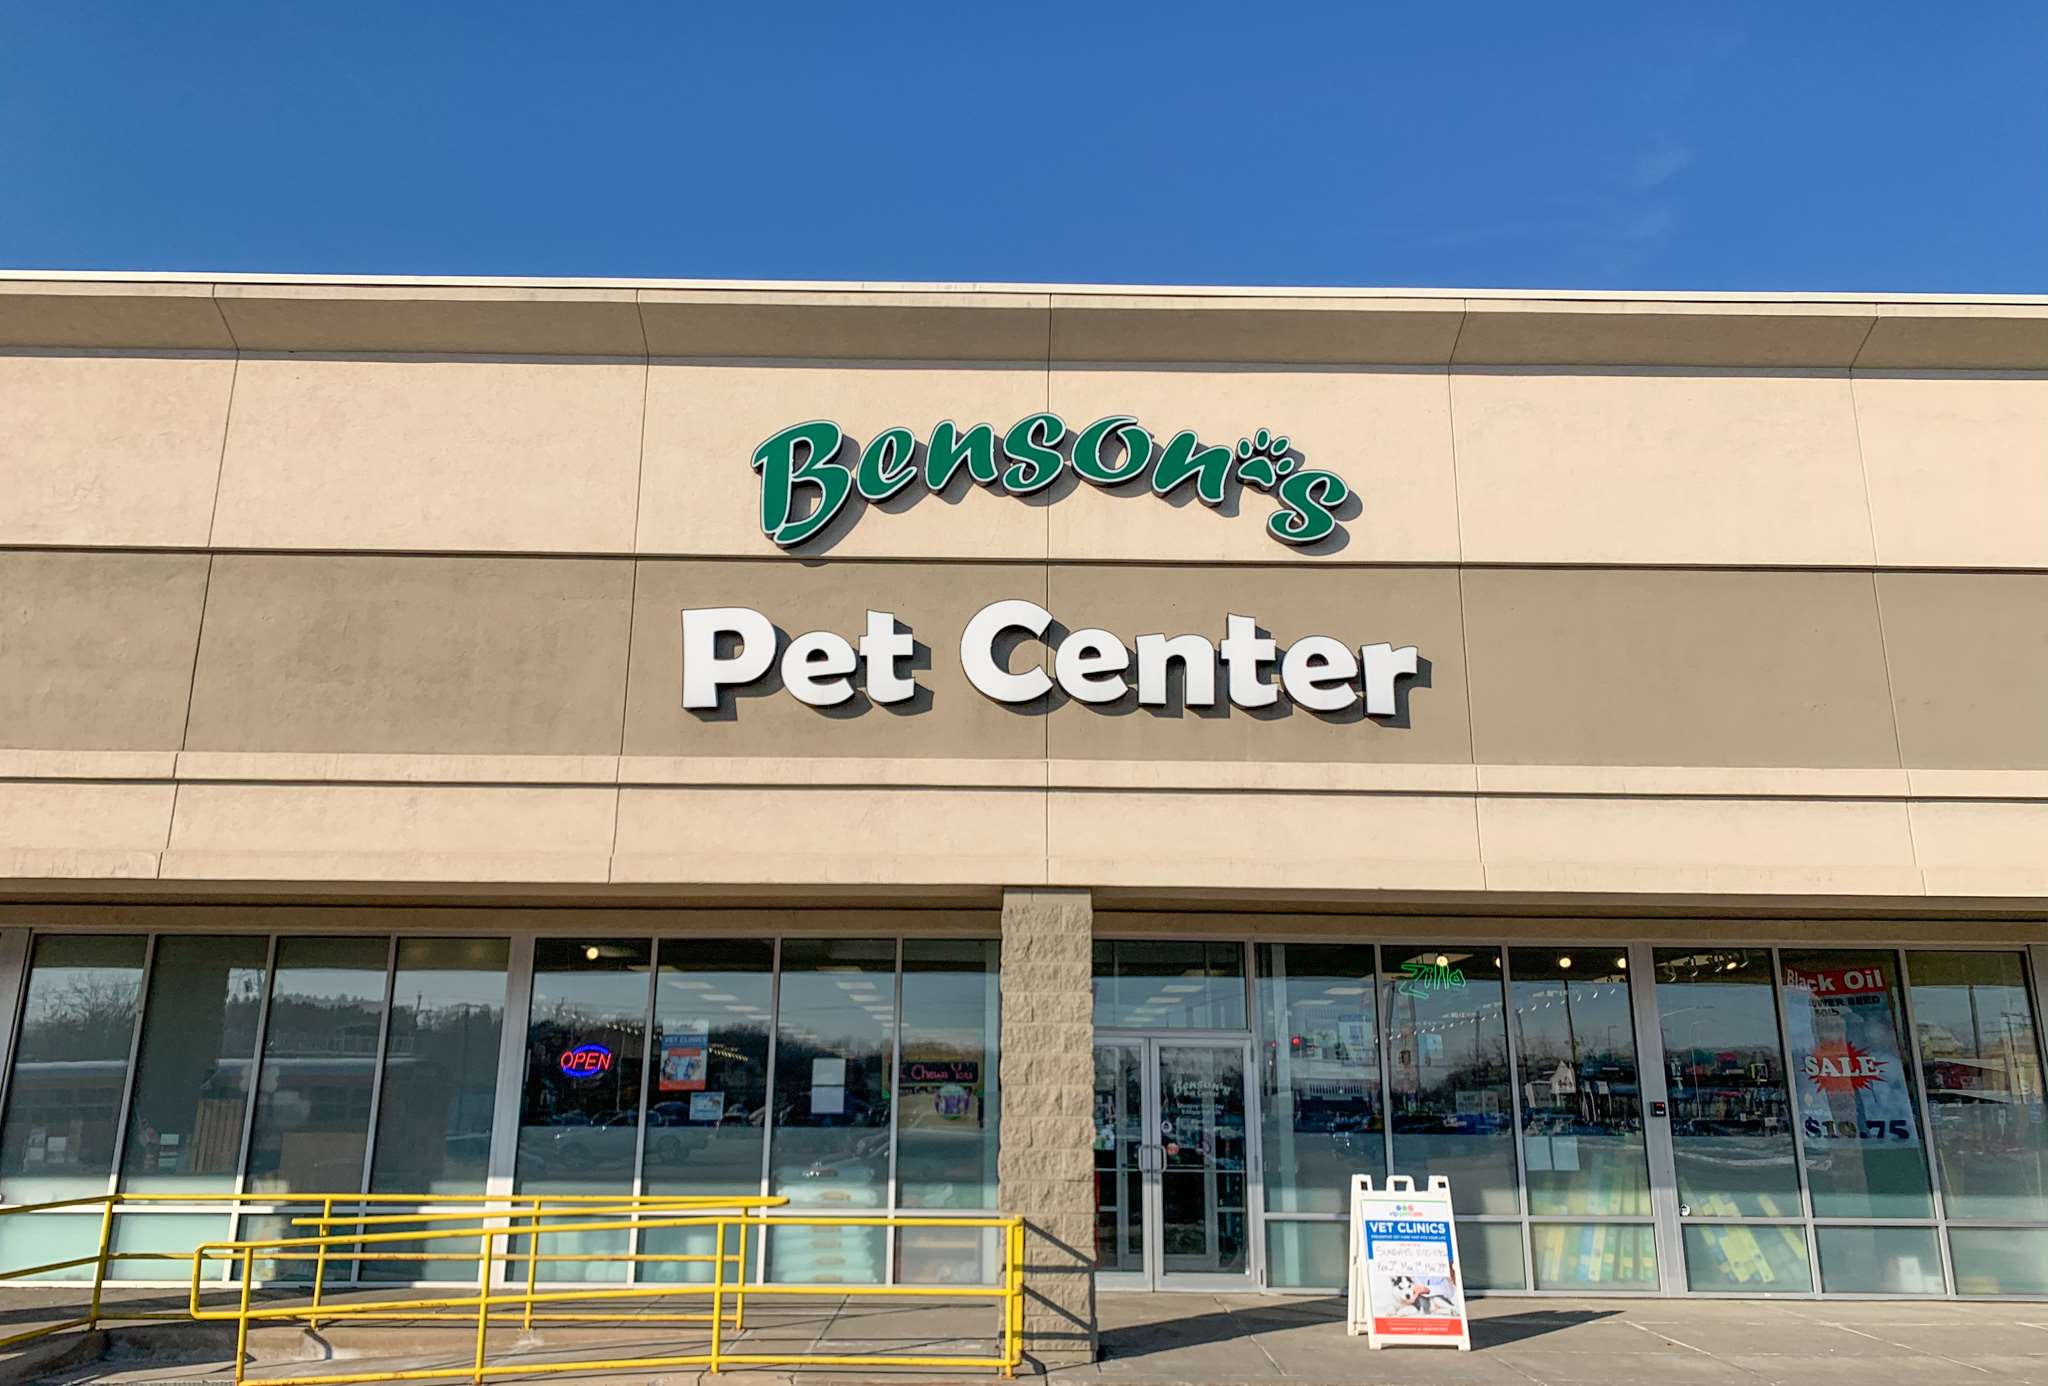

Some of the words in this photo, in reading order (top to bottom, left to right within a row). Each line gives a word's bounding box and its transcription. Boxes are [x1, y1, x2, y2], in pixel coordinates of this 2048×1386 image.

[681, 607, 915, 711] Pet
[960, 599, 1418, 716] Center
[1399, 963, 1467, 999] Zilla
[1787, 969, 1836, 992] Black
[1844, 969, 1883, 989] Oil
[561, 1051, 612, 1070] OPEN
[1804, 1055, 1881, 1077] SALE
[1369, 1222, 1394, 1233] VET
[1397, 1223, 1446, 1234] CLINICS
